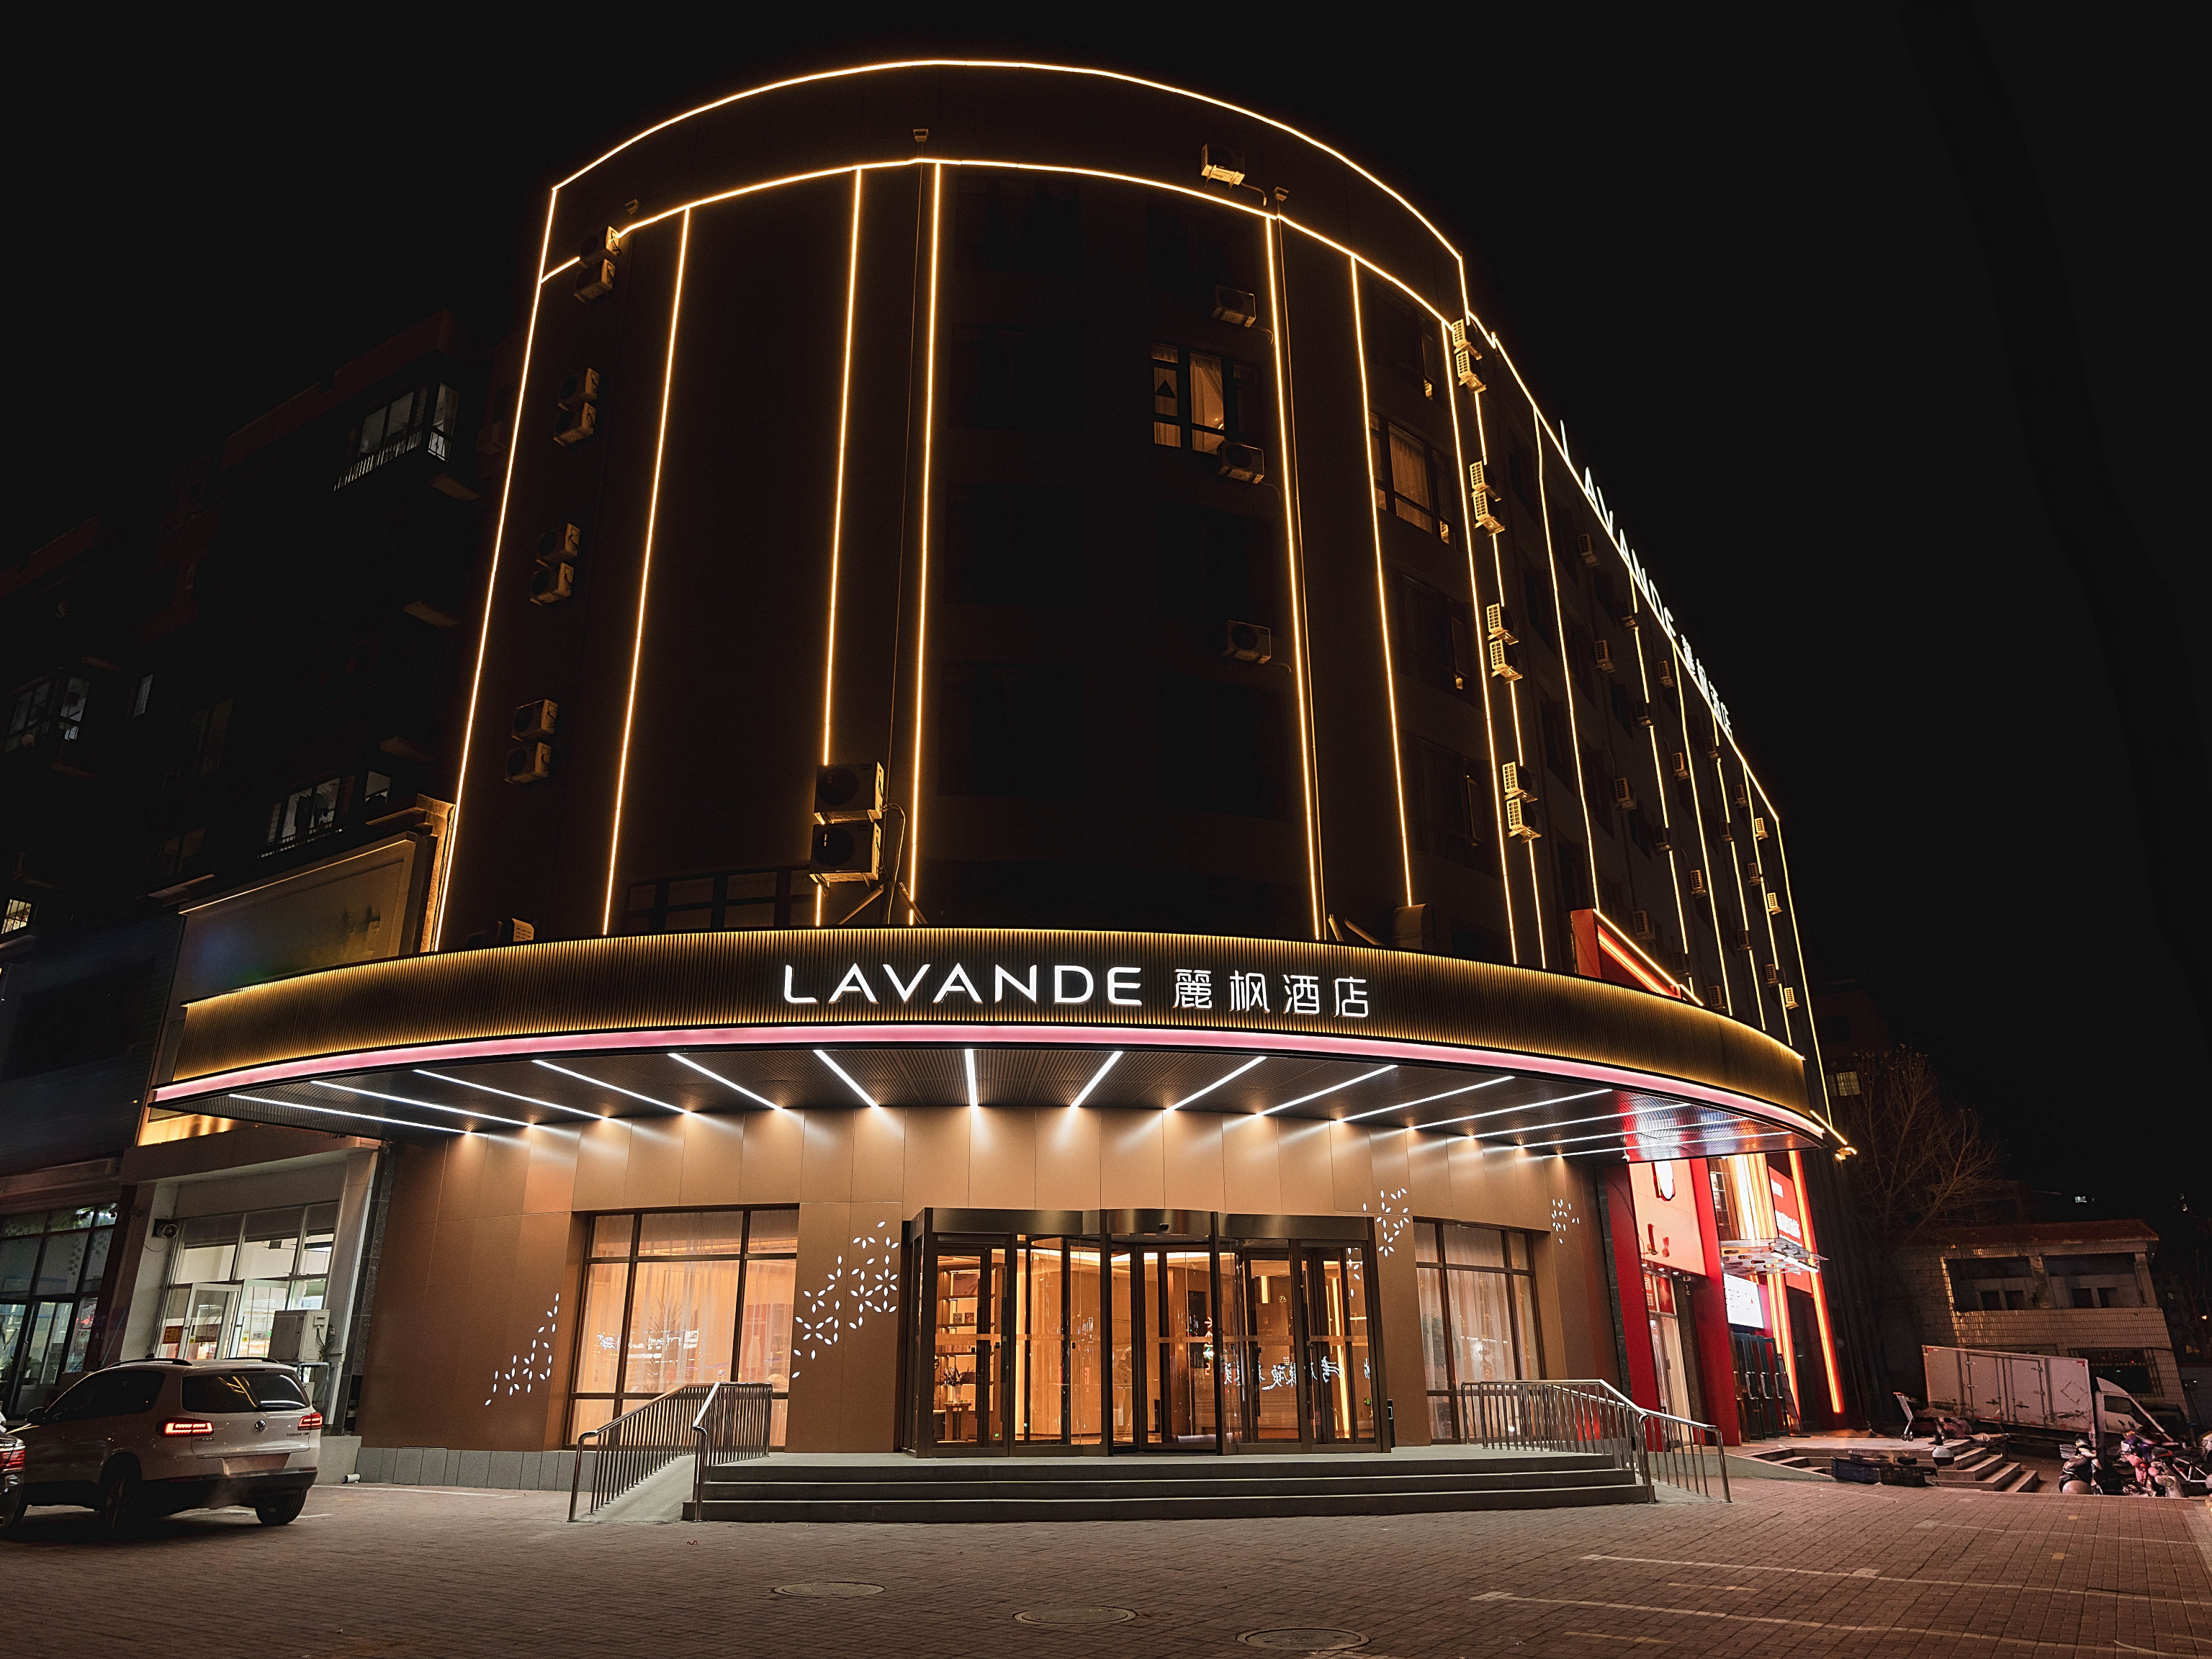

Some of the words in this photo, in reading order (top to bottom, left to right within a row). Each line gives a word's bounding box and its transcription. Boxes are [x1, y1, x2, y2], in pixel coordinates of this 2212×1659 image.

[783, 962, 1143, 1005] LAVANDE
[1173, 968, 1370, 1018] 麗枫酒店
